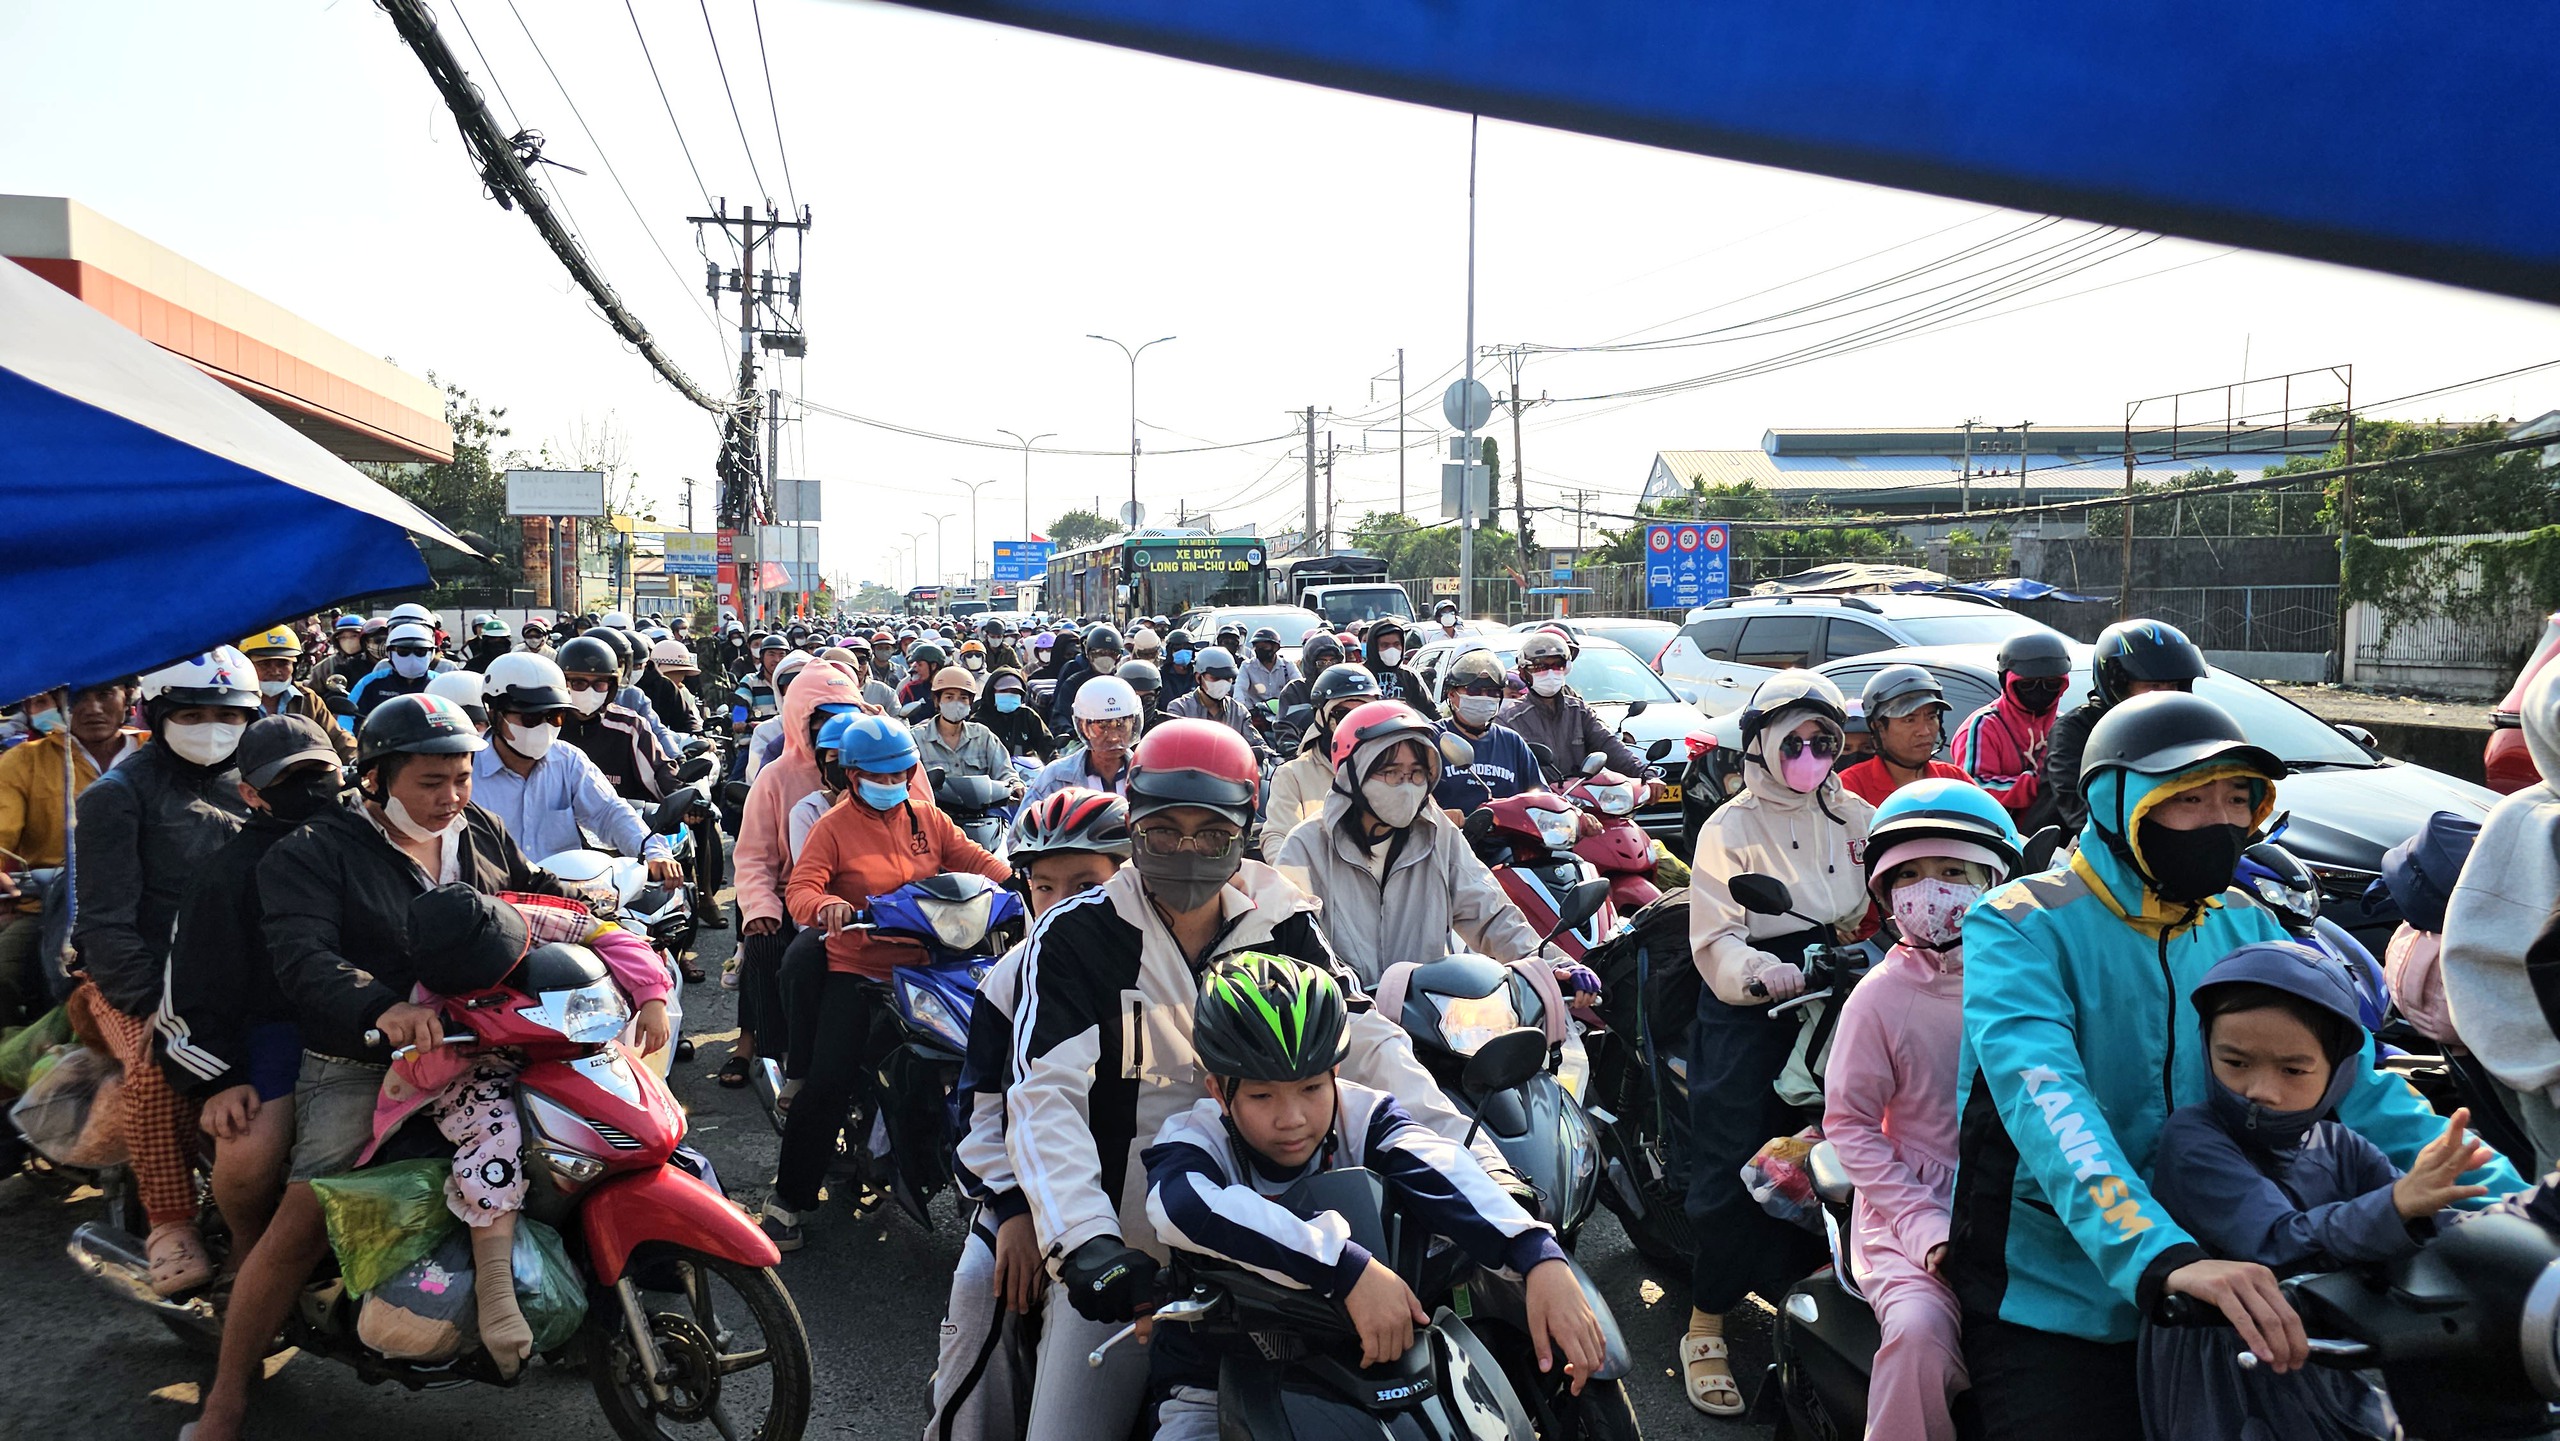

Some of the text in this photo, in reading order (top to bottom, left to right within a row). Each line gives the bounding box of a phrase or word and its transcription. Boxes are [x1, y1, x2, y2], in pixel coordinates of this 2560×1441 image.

[1656, 535, 1665, 545] 60
[1683, 534, 1693, 545] 60
[1710, 534, 1720, 544] 60
[1176, 546, 1223, 560] XE BUÝT
[1150, 561, 1179, 573] LONG
[1228, 559, 1249, 572] LỚN
[721, 595, 729, 604] P
[267, 632, 287, 644] be
[2088, 1176, 2154, 1242] SM
[1376, 1379, 1433, 1402] HONDA
